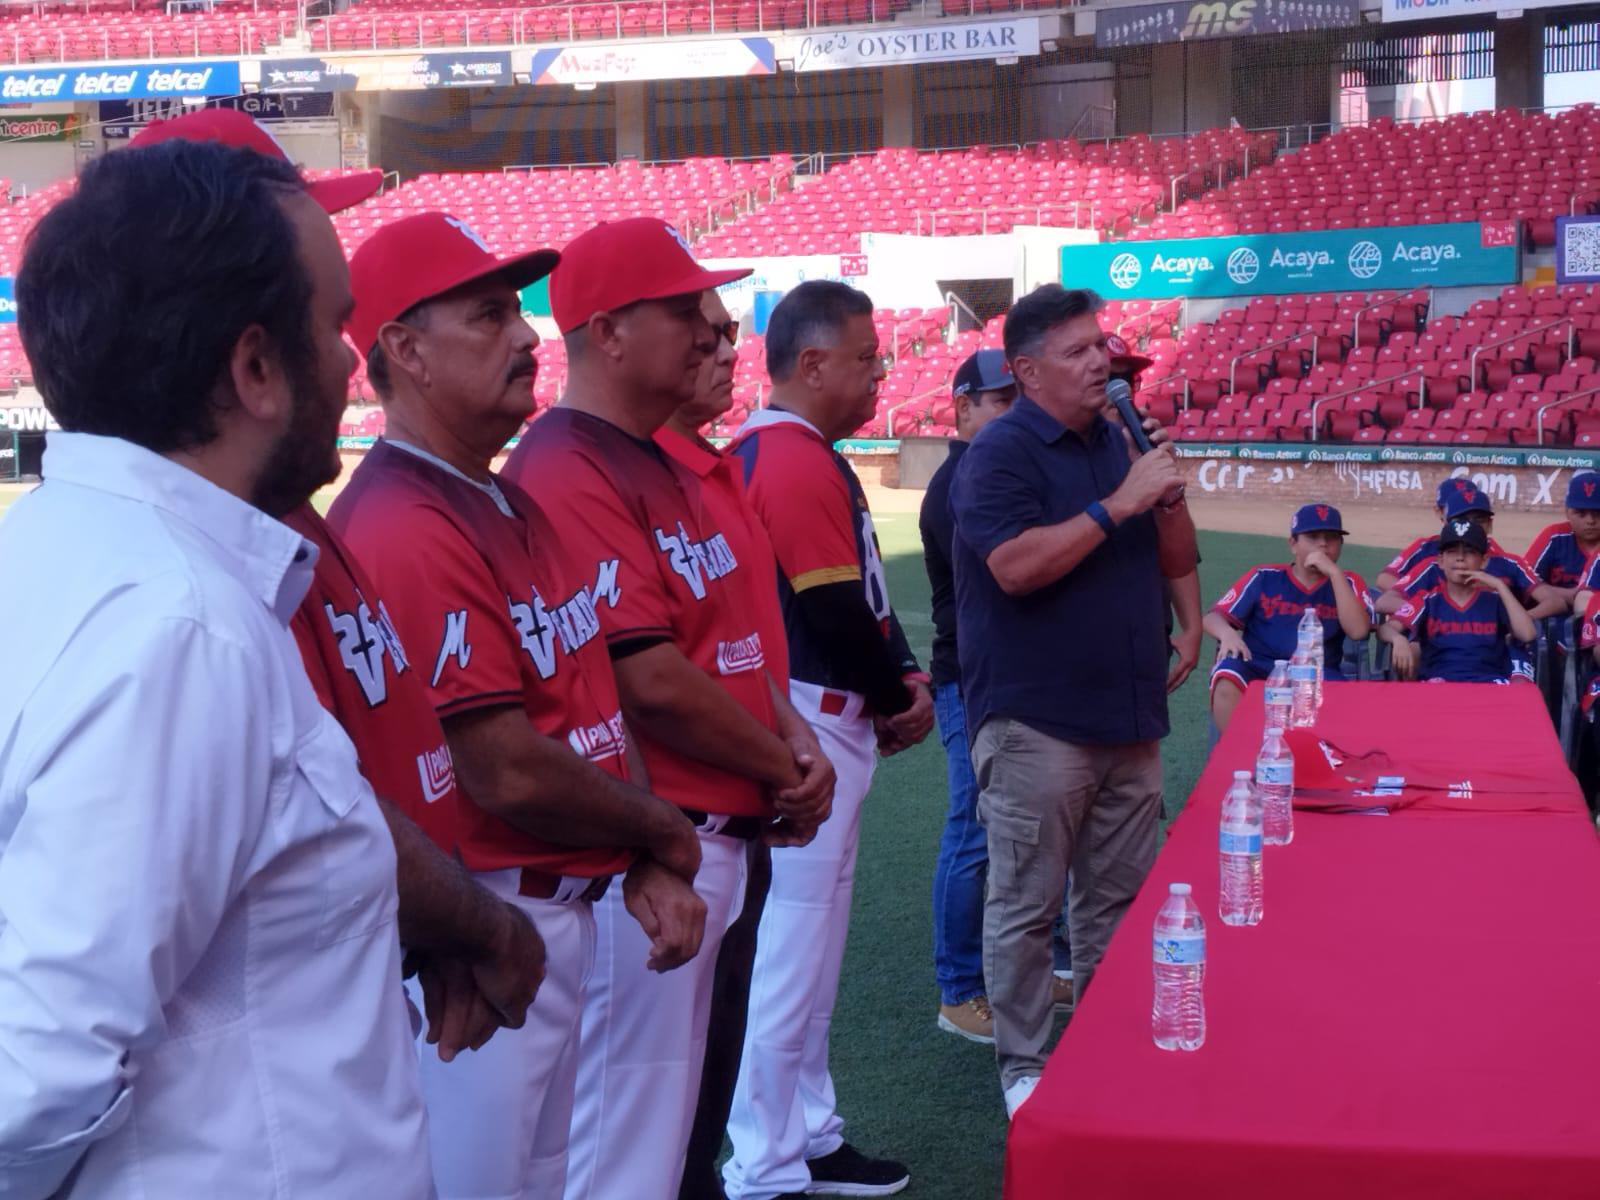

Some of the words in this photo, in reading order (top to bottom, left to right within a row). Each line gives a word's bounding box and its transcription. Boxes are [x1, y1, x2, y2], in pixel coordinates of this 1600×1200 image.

[858, 31, 955, 57] OYSTER
[965, 26, 1016, 49] BAR
[2, 73, 67, 97] telcel
[73, 70, 138, 94] telcel
[147, 67, 213, 91] telcel
[1346, 450, 1372, 461] Azteca
[1466, 454, 1489, 464] Banco
[1490, 454, 1517, 465] Azteca
[1566, 455, 1593, 467] Azteca
